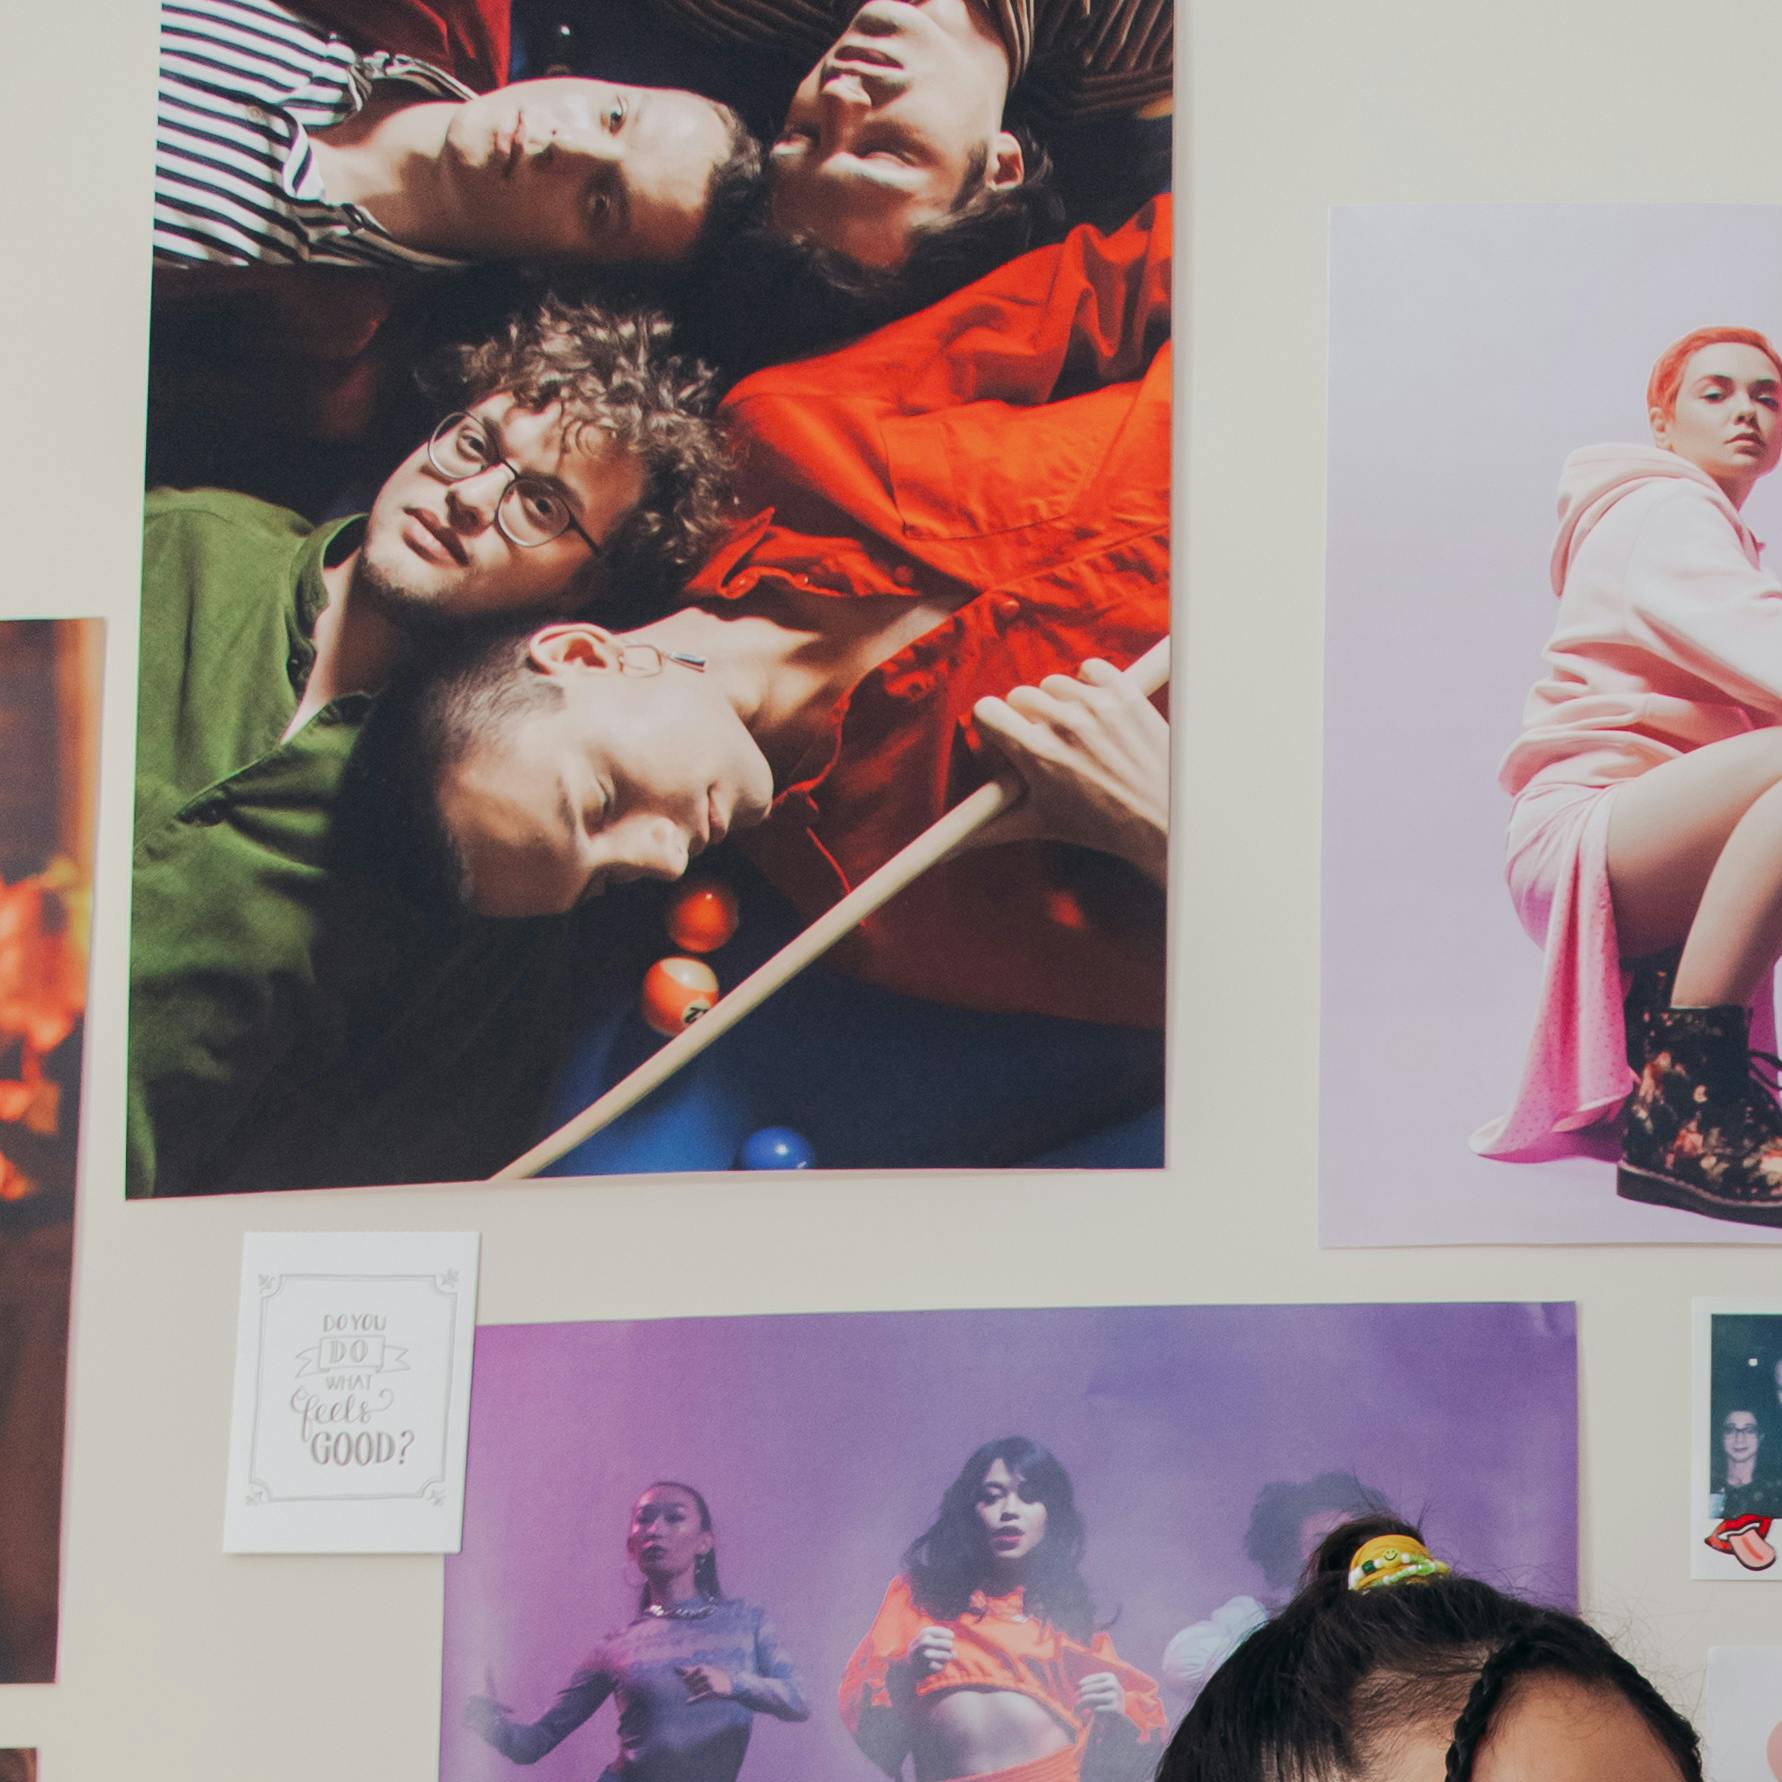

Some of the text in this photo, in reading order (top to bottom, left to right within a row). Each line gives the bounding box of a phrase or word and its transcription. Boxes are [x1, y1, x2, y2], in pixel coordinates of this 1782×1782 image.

[323, 1314, 387, 1332] DO YOU
[329, 1340, 369, 1364] DO
[326, 1374, 372, 1391] WHAT
[291, 1386, 394, 1443] feels
[311, 1431, 415, 1466] GOOD?
